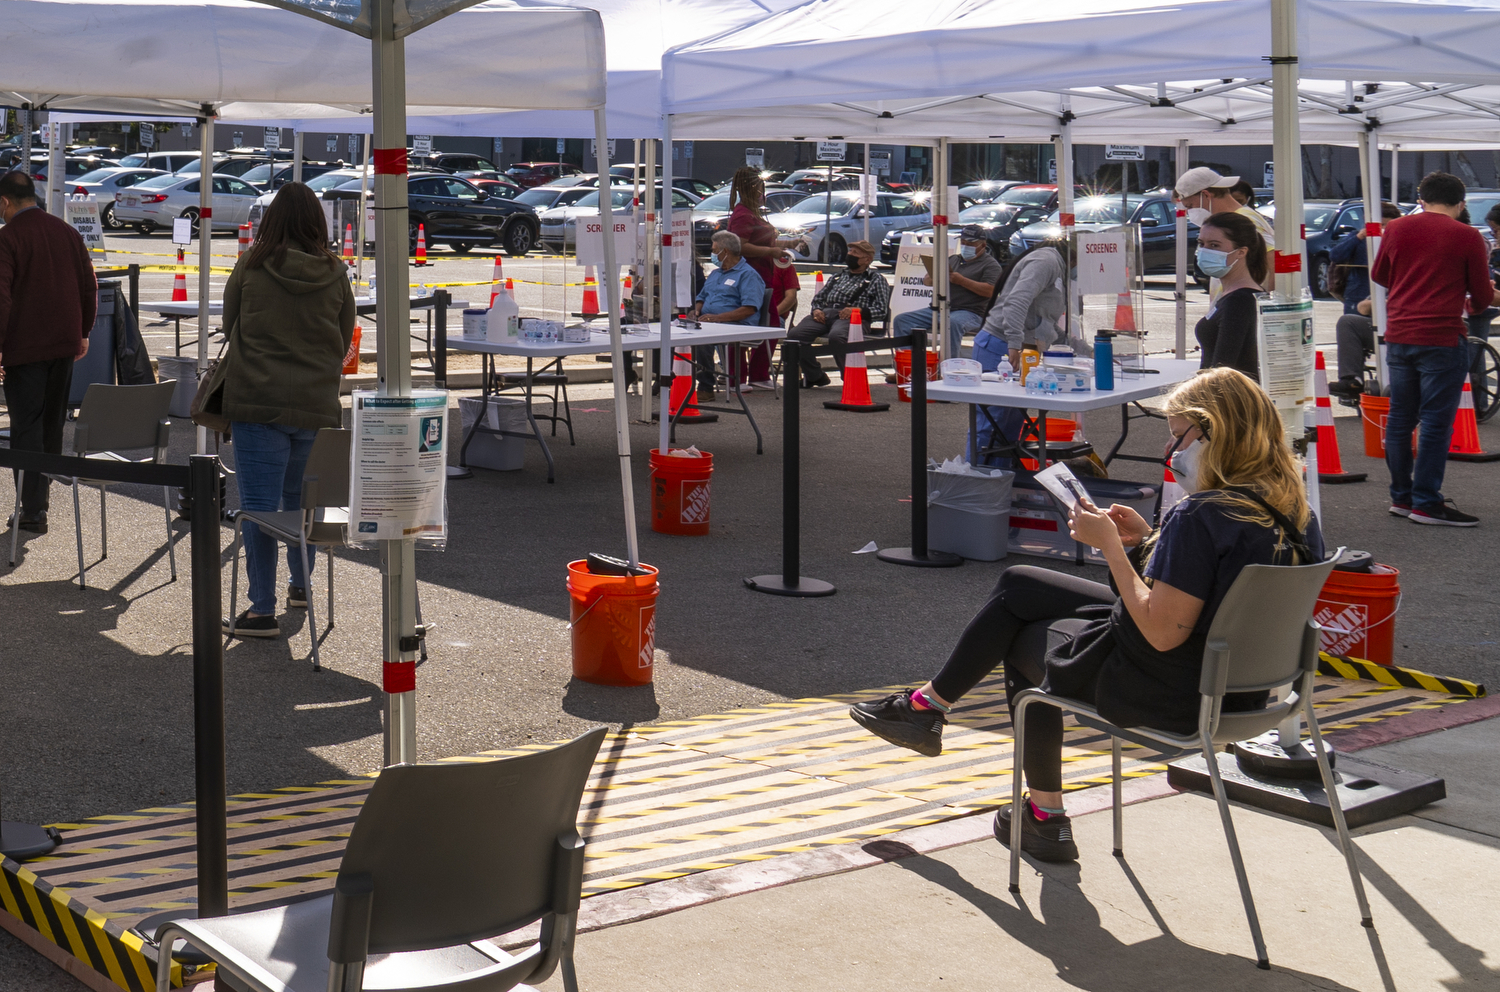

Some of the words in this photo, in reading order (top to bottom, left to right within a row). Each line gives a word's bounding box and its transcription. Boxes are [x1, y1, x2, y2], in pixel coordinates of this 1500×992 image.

[79, 225, 93, 233] DROP
[587, 223, 626, 233] SCRER
[1085, 243, 1118, 253] SCREENER
[1099, 262, 1105, 273] A
[900, 276, 924, 286] VACCIN
[902, 288, 933, 298] ENTRANC
